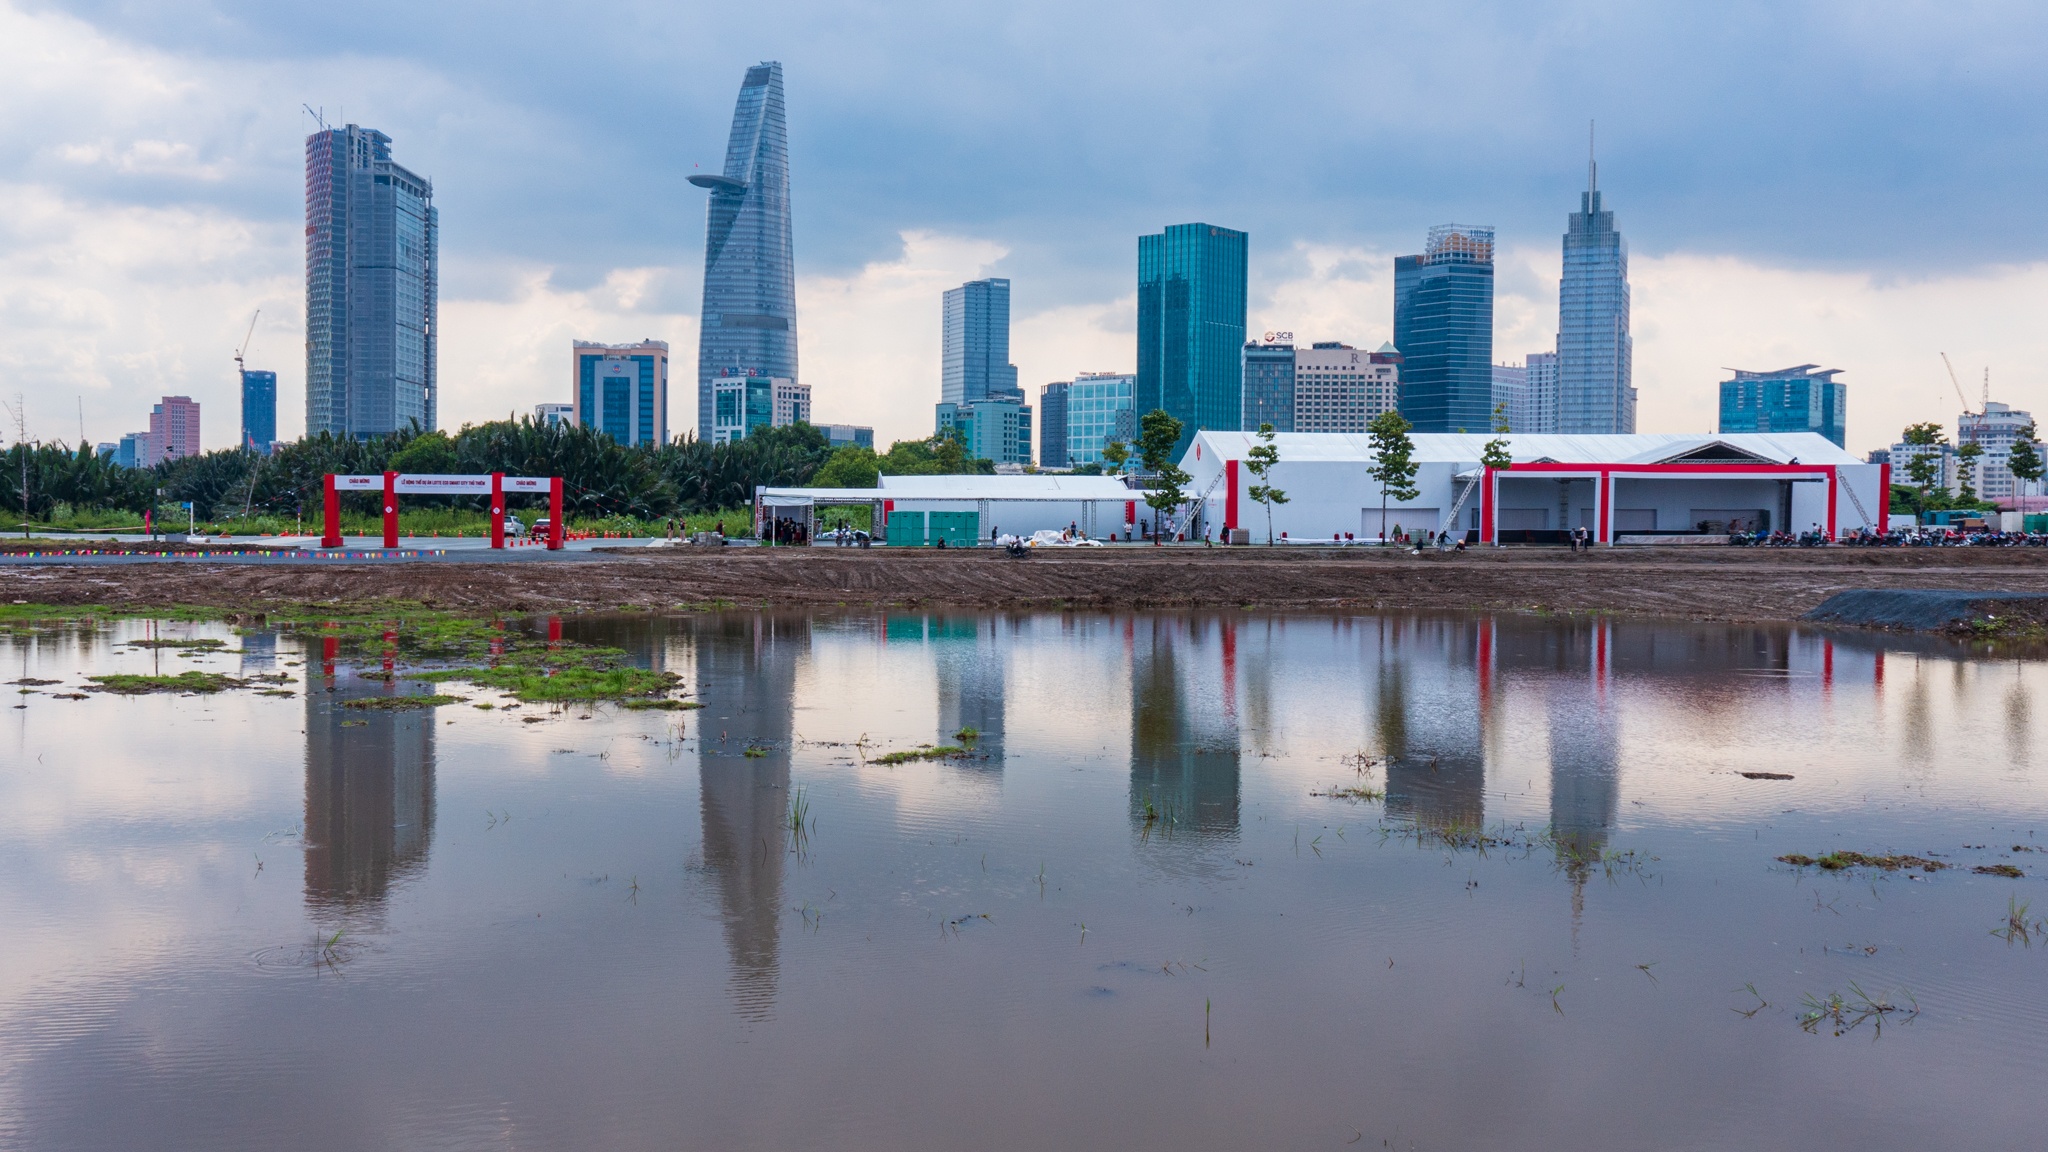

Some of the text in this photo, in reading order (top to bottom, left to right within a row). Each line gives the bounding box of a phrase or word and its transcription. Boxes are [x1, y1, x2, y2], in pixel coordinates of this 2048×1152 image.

[1470, 229, 1494, 238] Hilton
[1276, 331, 1293, 339] SCB
[1351, 353, 1360, 363] R
